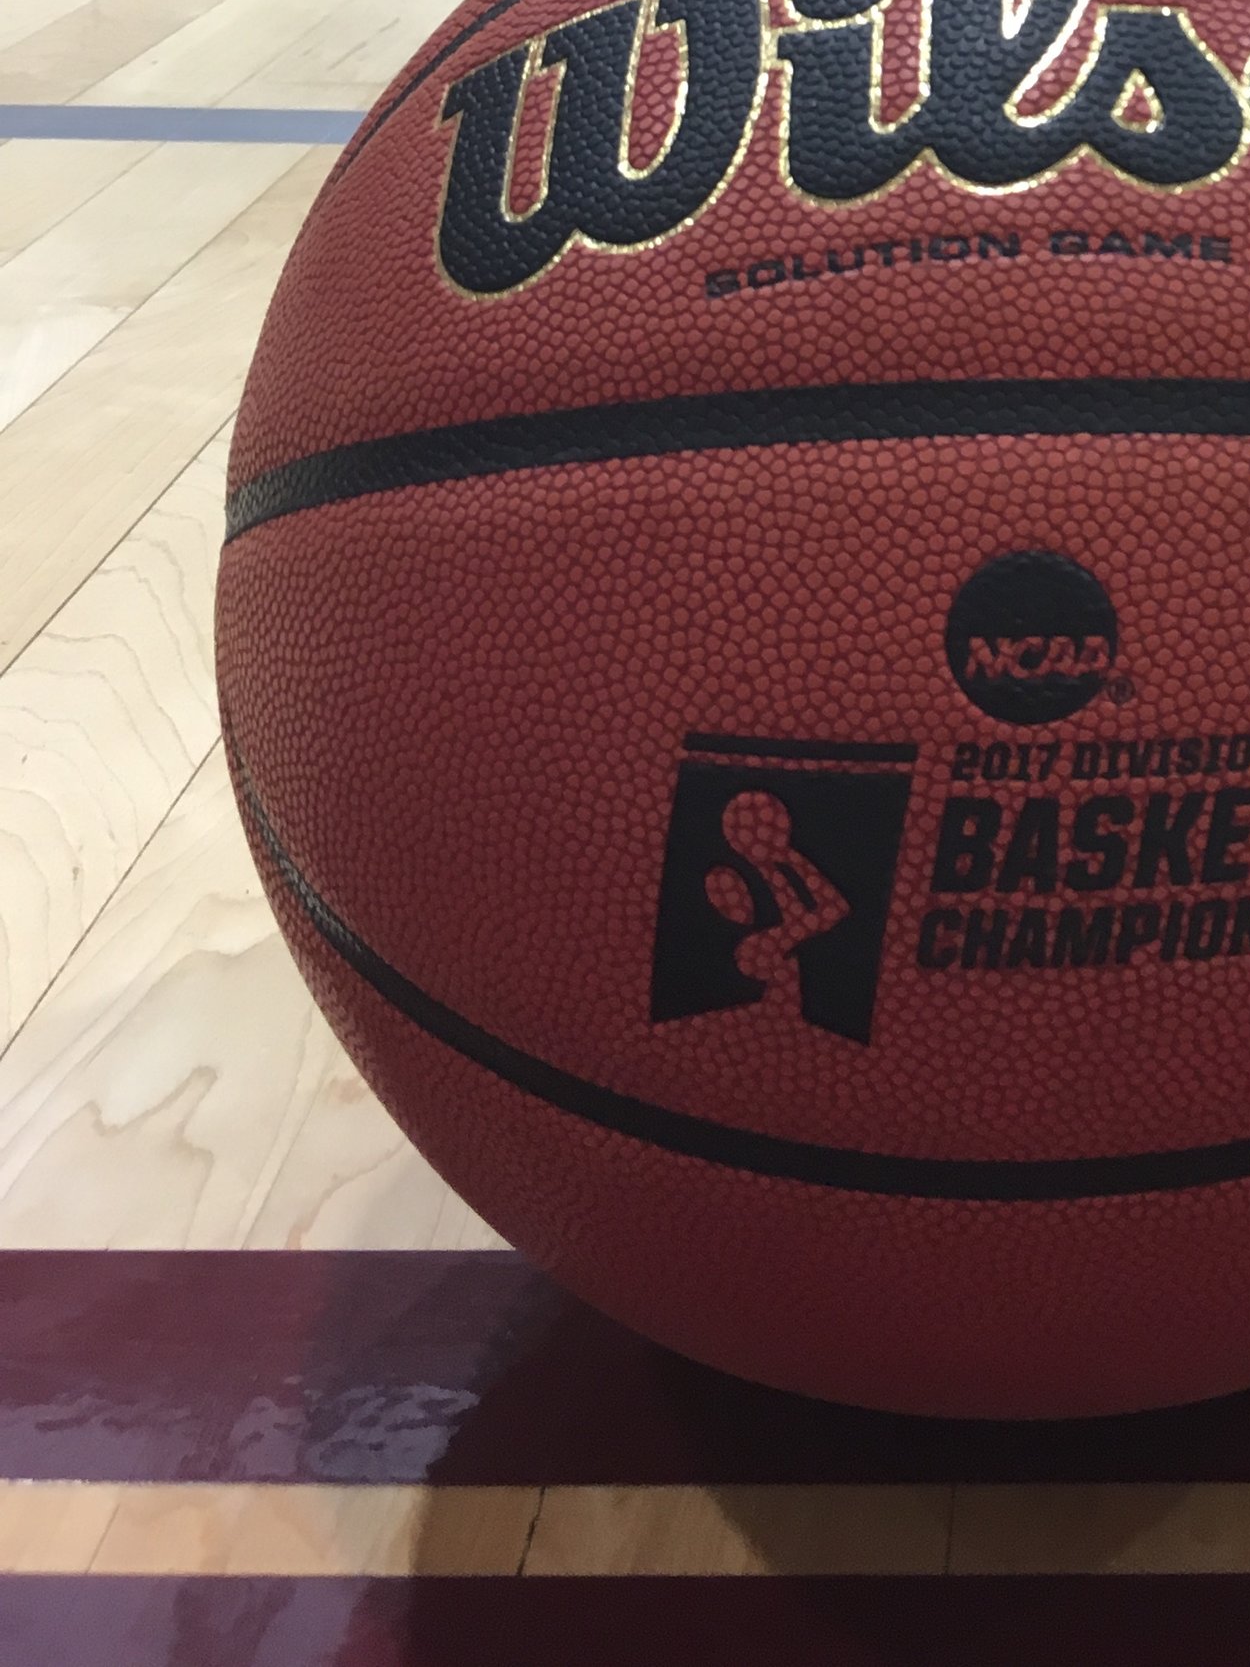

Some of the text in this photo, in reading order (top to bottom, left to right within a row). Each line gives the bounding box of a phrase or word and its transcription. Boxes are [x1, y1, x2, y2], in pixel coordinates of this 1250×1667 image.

[705, 231, 1021, 298] SOLUTION
[1050, 230, 1231, 264] GAME
[964, 634, 1110, 680] NCAA
[952, 742, 1059, 782] 2017
